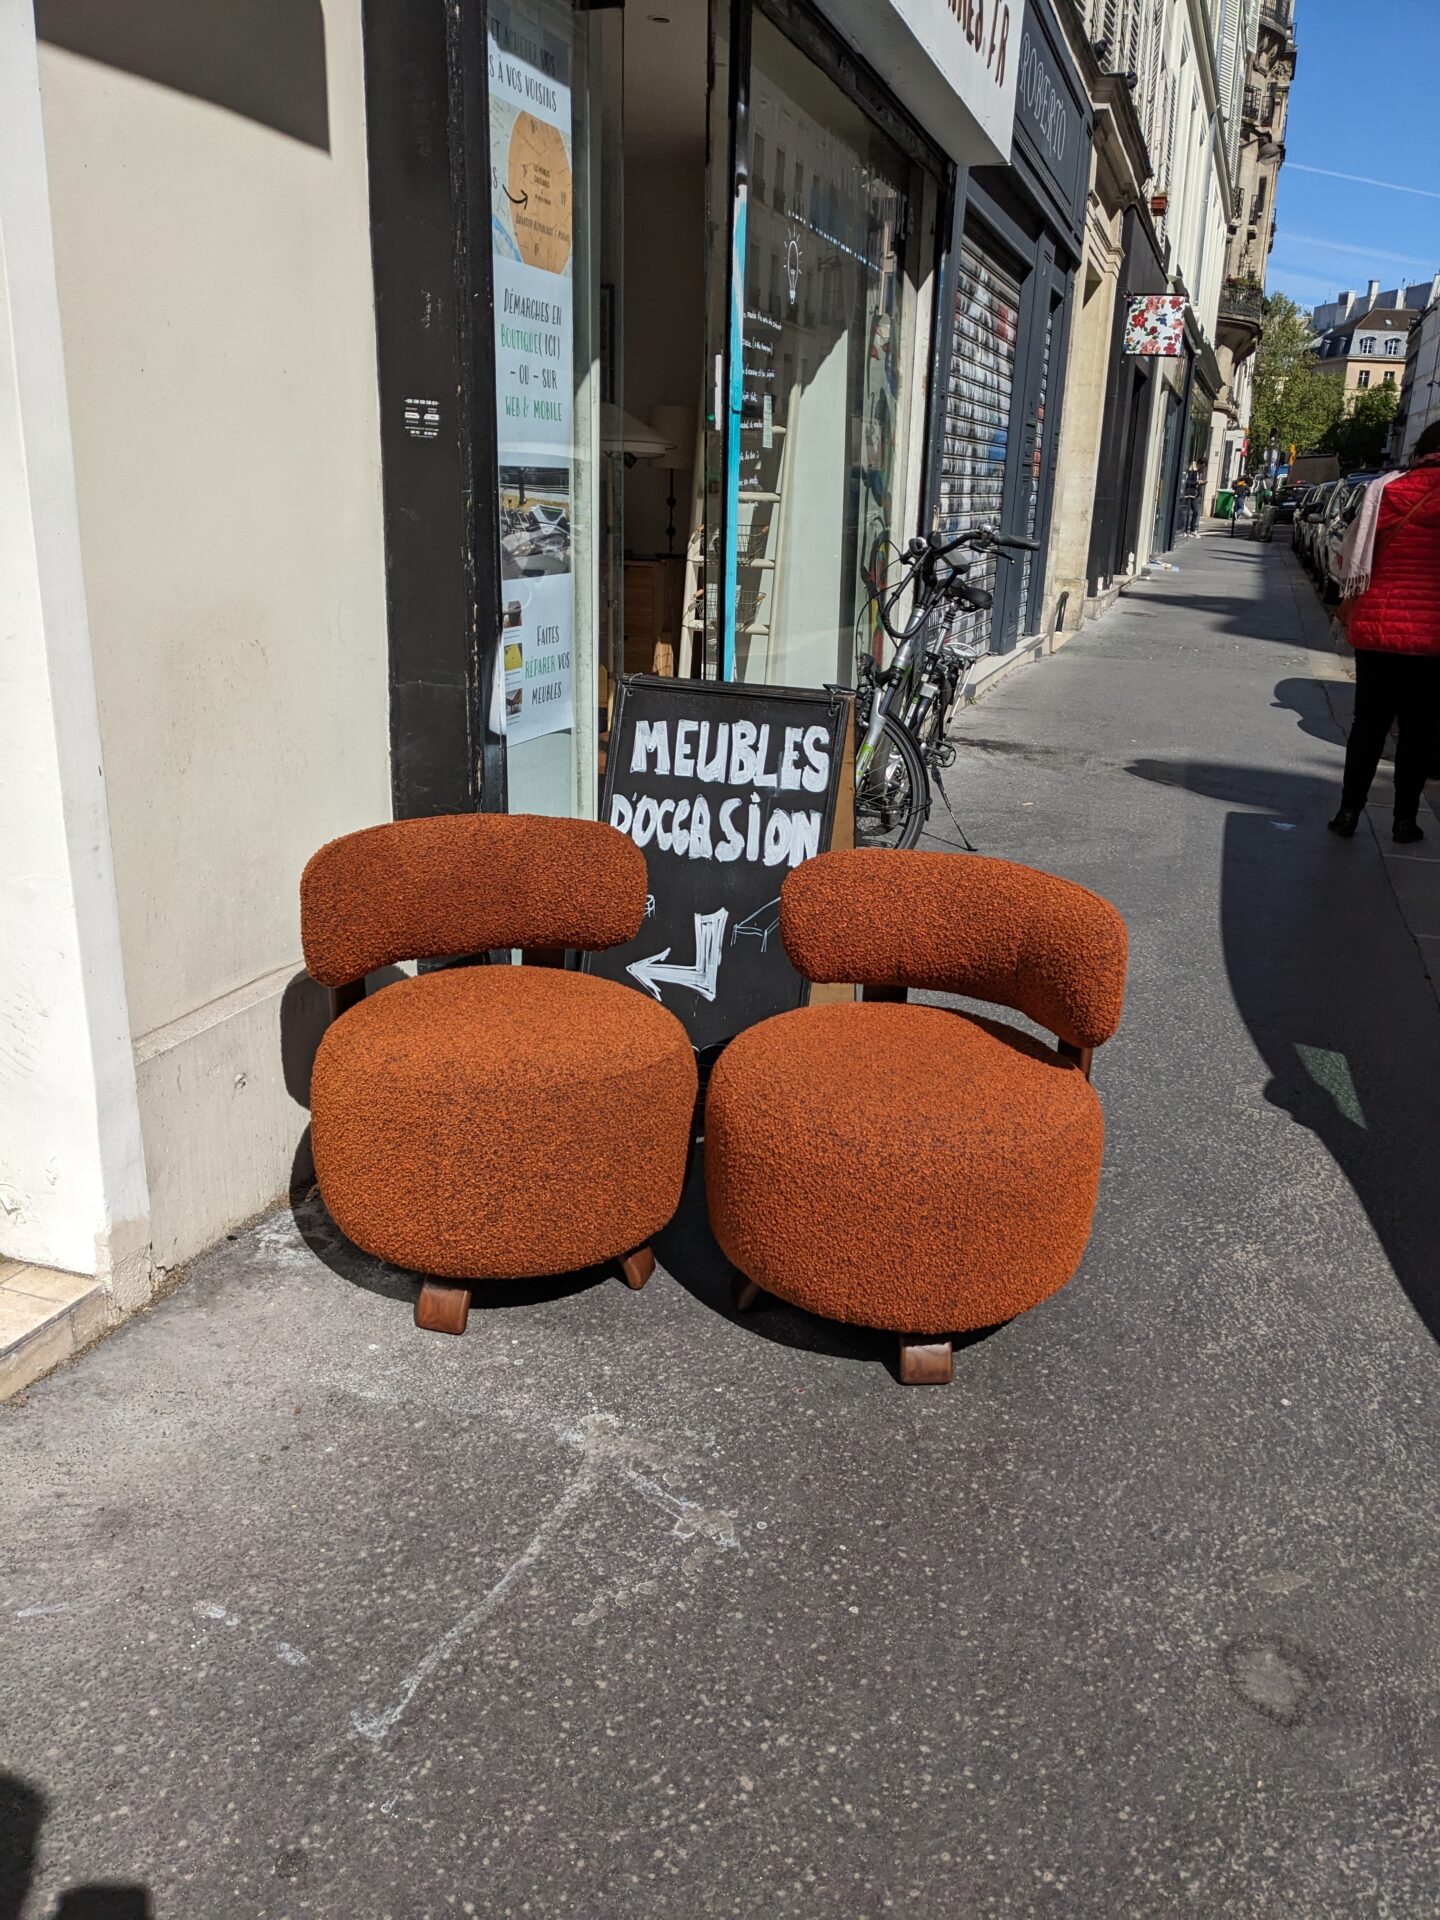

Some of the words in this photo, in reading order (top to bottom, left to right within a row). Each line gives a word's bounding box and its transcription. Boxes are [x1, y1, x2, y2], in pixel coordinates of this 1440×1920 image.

[506, 64, 522, 93] VOS
[525, 75, 557, 112] VOISINS
[1018, 32, 1067, 160] ROBERTO
[503, 288, 549, 323] DÉMARCHES
[552, 305, 562, 326] EN
[519, 364, 529, 385] OU
[542, 368, 557, 390] SUR
[505, 395, 520, 418] WEB
[533, 399, 562, 421] MOBILE
[537, 625, 560, 646] FAITES
[524, 656, 556, 679] RÉPARER
[557, 651, 570, 671] VOS
[531, 682, 562, 706] MEUBLES
[630, 719, 830, 793] MEUBLES
